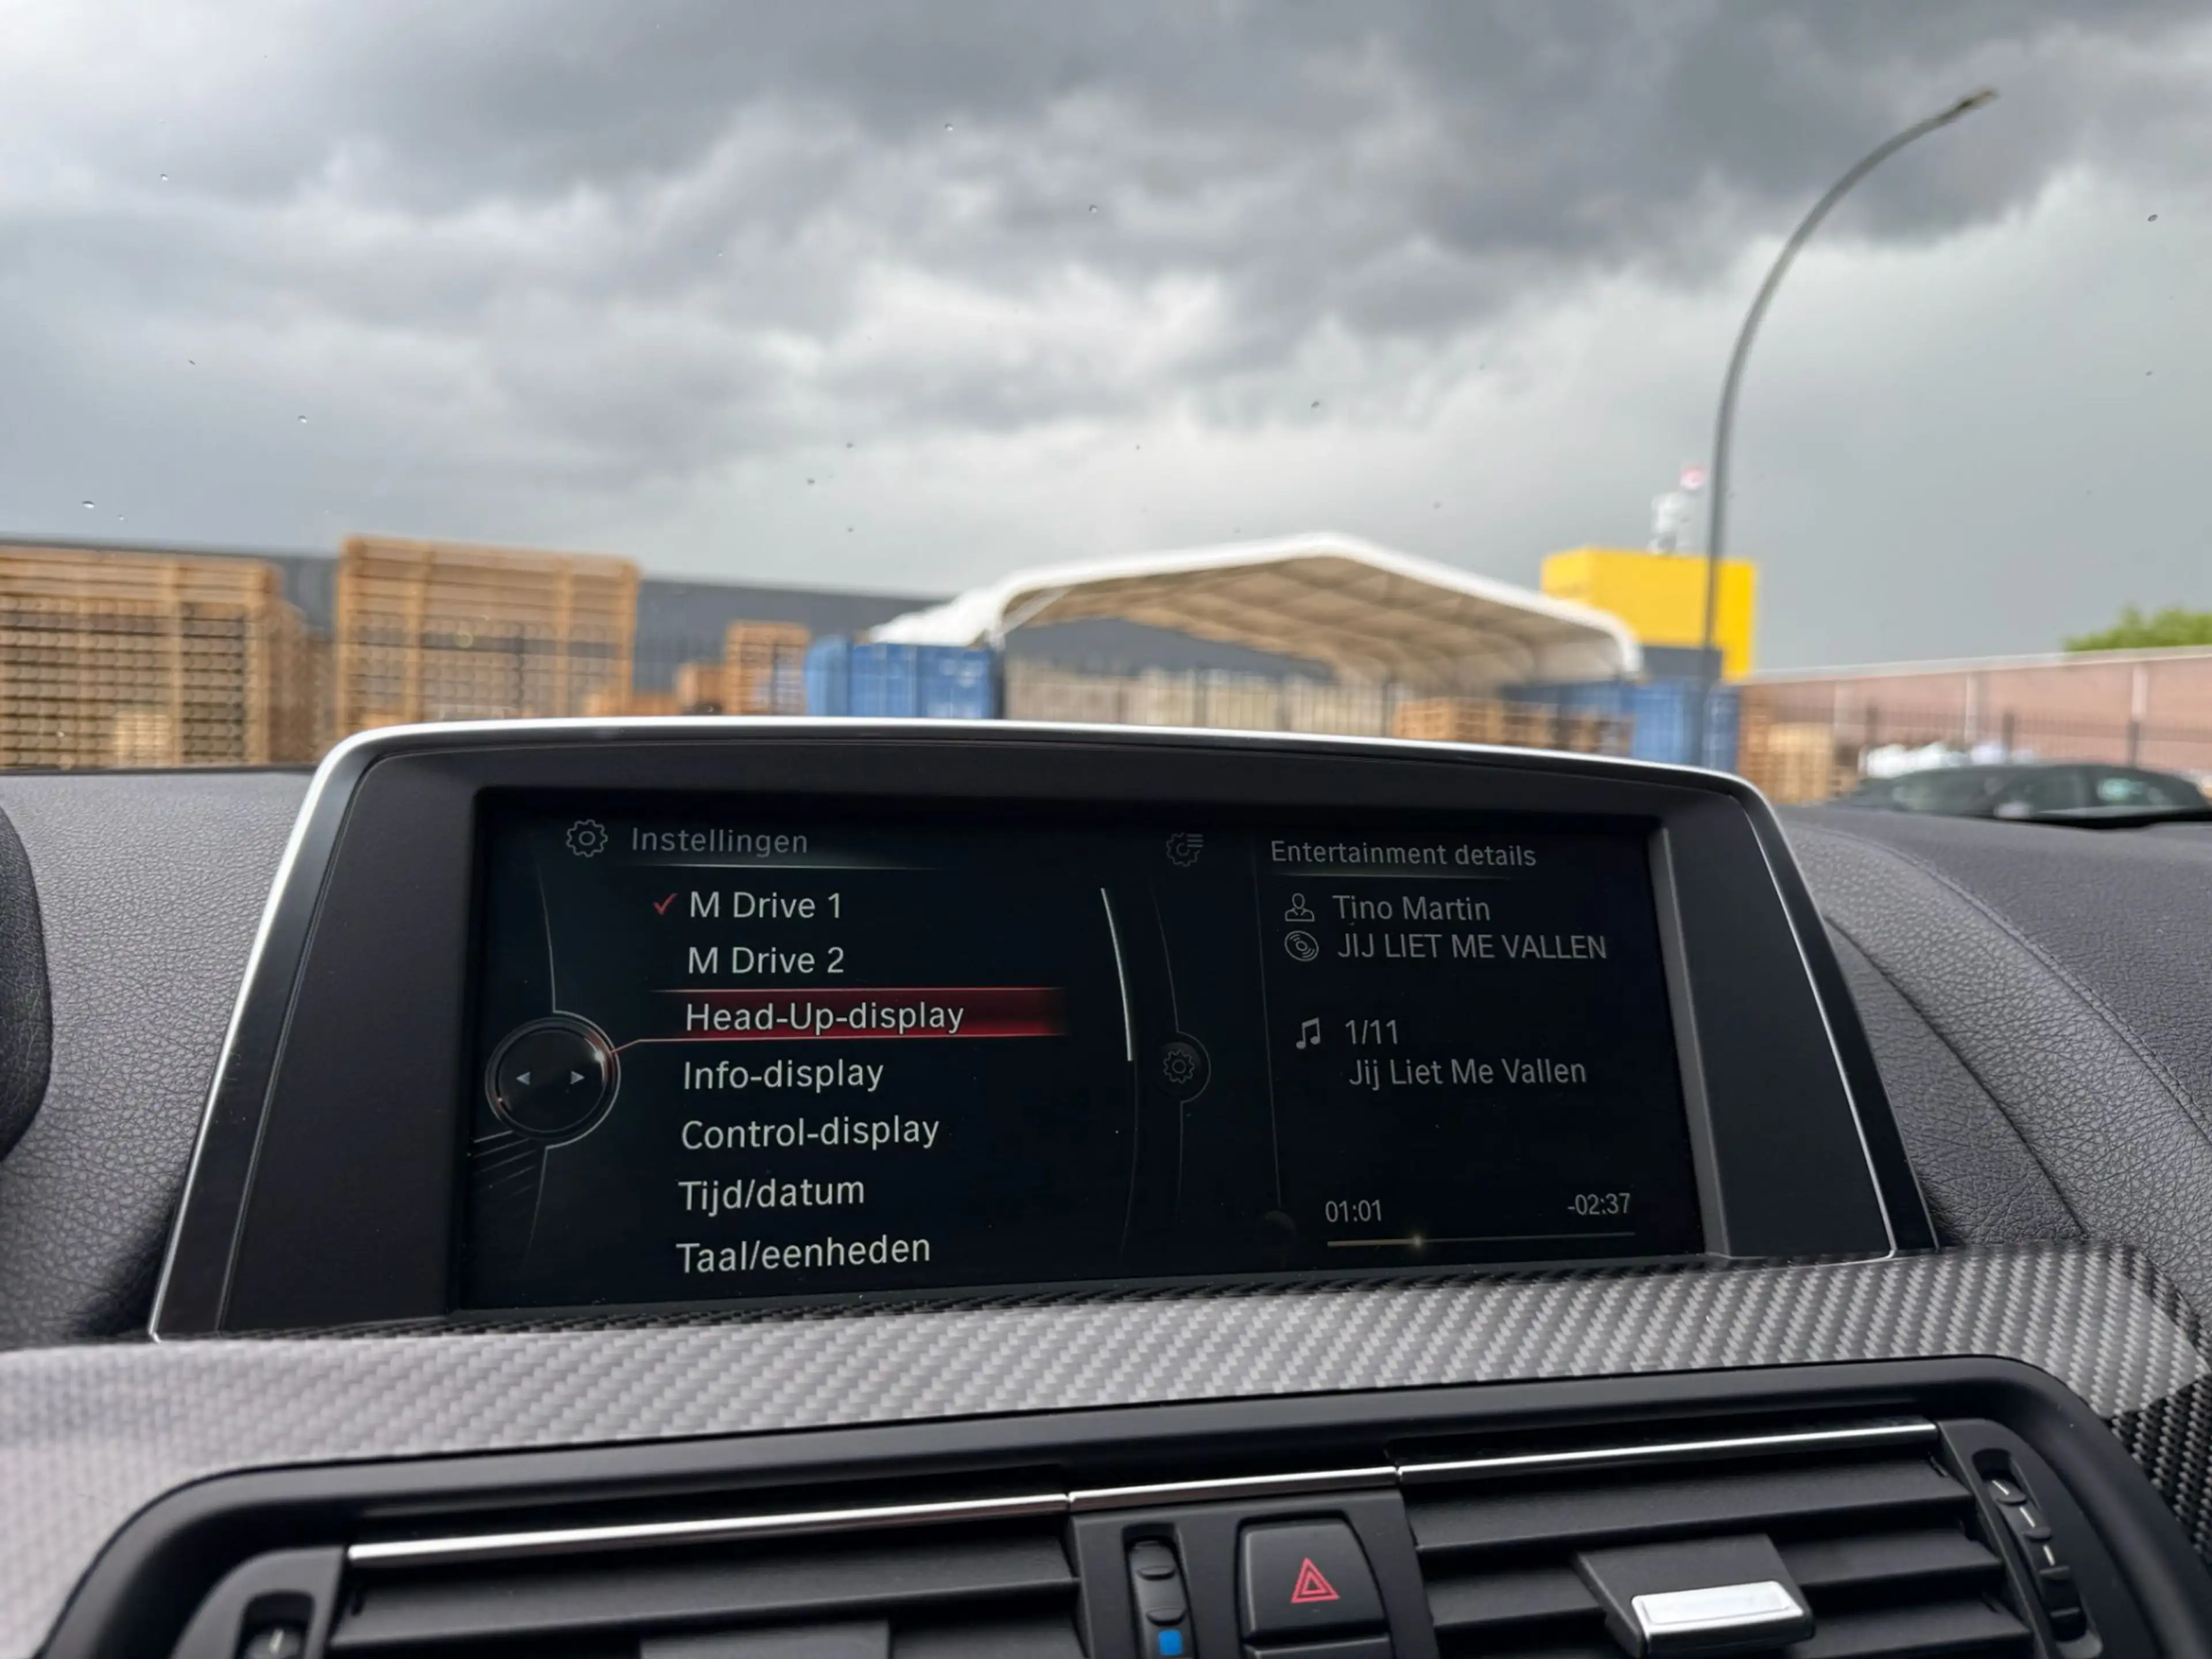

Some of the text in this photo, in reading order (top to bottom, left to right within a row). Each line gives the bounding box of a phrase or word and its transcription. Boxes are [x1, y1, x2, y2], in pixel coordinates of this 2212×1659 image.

[632, 827, 808, 858] Instellingen
[1271, 840, 1536, 866] Entertainment details
[690, 891, 839, 919] M Drive 1
[1332, 895, 1490, 921] Tino Martin
[688, 946, 844, 974] M Drive 2
[1338, 933, 1607, 959] JIJ LIET ME VALLEN
[686, 1001, 965, 1035] Head-Up-display
[1345, 1019, 1397, 1045] 1/11
[684, 1058, 884, 1094] Info-display
[1349, 1058, 1586, 1091] Jij Liet Me Vallen
[681, 1115, 940, 1150] Control-display
[678, 1178, 864, 1217] Tijd/datum
[1325, 1199, 1381, 1223] 01:01
[1567, 1192, 1631, 1216] -02:37
[676, 1234, 930, 1273] Taal/eenheden
